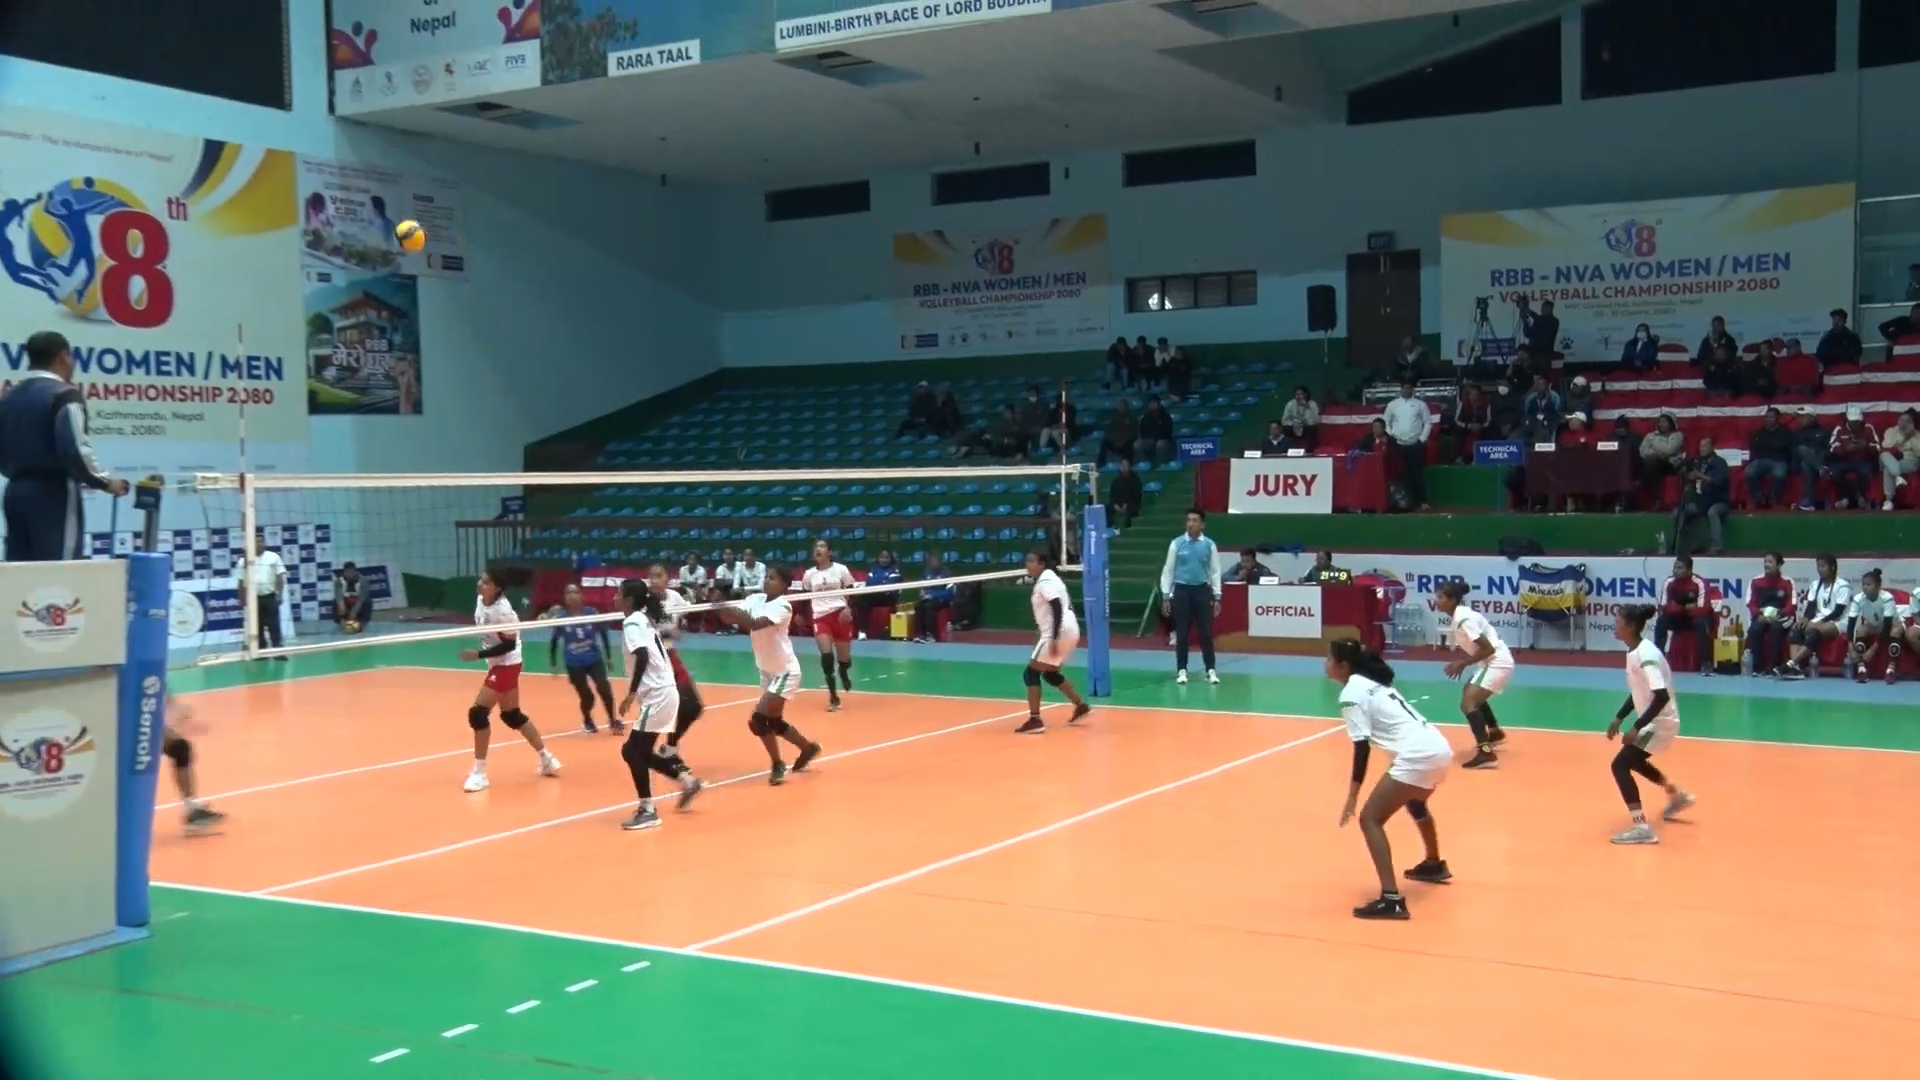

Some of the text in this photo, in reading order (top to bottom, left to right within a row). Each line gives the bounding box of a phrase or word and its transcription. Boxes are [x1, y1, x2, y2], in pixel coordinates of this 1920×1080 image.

[410, 10, 456, 37] Nepal
[779, 13, 872, 40] LUMBINI-BIRTH
[874, 6, 919, 25] PLACE
[923, 4, 941, 18] OF
[945, 0, 983, 16] LORD
[616, 46, 693, 71] RARA TAAL
[1633, 225, 1656, 258] 8
[101, 208, 174, 329] 8
[166, 196, 188, 222] th
[997, 243, 1015, 274] 8
[1490, 268, 1535, 288] RBB
[1555, 263, 1605, 285] NVA
[1609, 256, 1712, 281] WOMEN
[1731, 251, 1792, 275] MEN
[913, 283, 940, 297] RBB
[951, 281, 981, 295] NVA
[983, 275, 1042, 291] WOMEN
[1053, 271, 1087, 286] MEN
[1601, 279, 1734, 299] CHAMPIONSHIP
[1736, 276, 1781, 293] 2080
[919, 296, 978, 309] VOLLEYBALL
[980, 290, 1055, 304] CHAMPIONSHIP
[221, 353, 285, 382] MEN
[1180, 441, 1215, 450] TECHNICAL
[1189, 448, 1206, 456] AREA
[1479, 444, 1519, 454] TECHNICAL
[1488, 452, 1509, 460] AREA
[1246, 473, 1319, 497] JURY
[1255, 604, 1315, 618] OFFICIAL
[135, 697, 157, 770] Senoh
